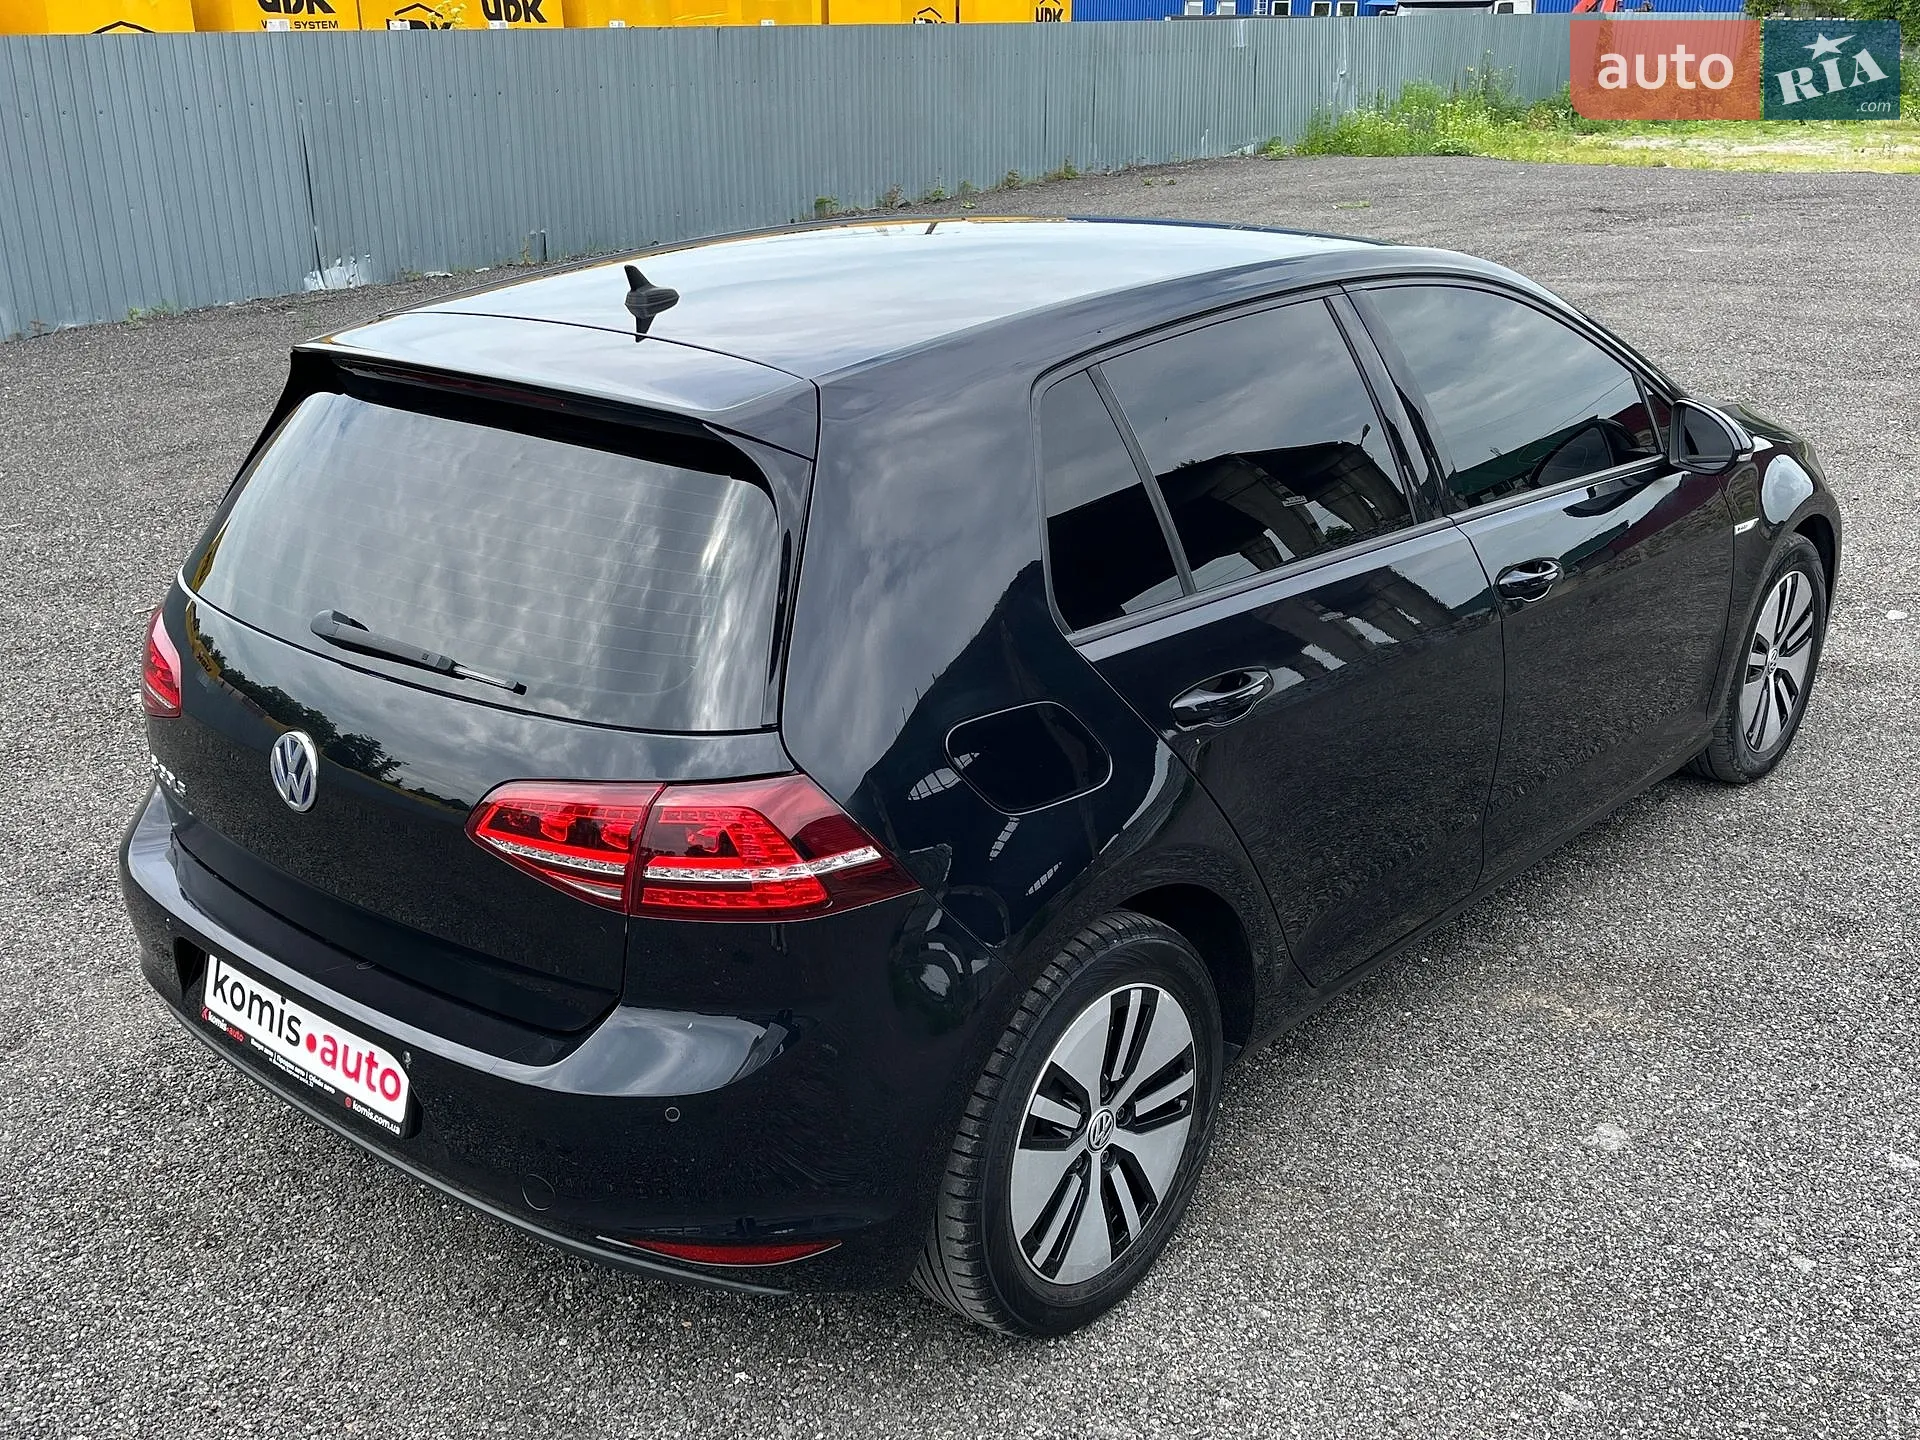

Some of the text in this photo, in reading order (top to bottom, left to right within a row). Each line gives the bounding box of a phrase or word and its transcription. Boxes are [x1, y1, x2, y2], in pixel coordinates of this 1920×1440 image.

[1035, 7, 1064, 22] UDK
[294, 20, 338, 29] SYSTEM
[352, 1100, 401, 1135] komis.com.ua
